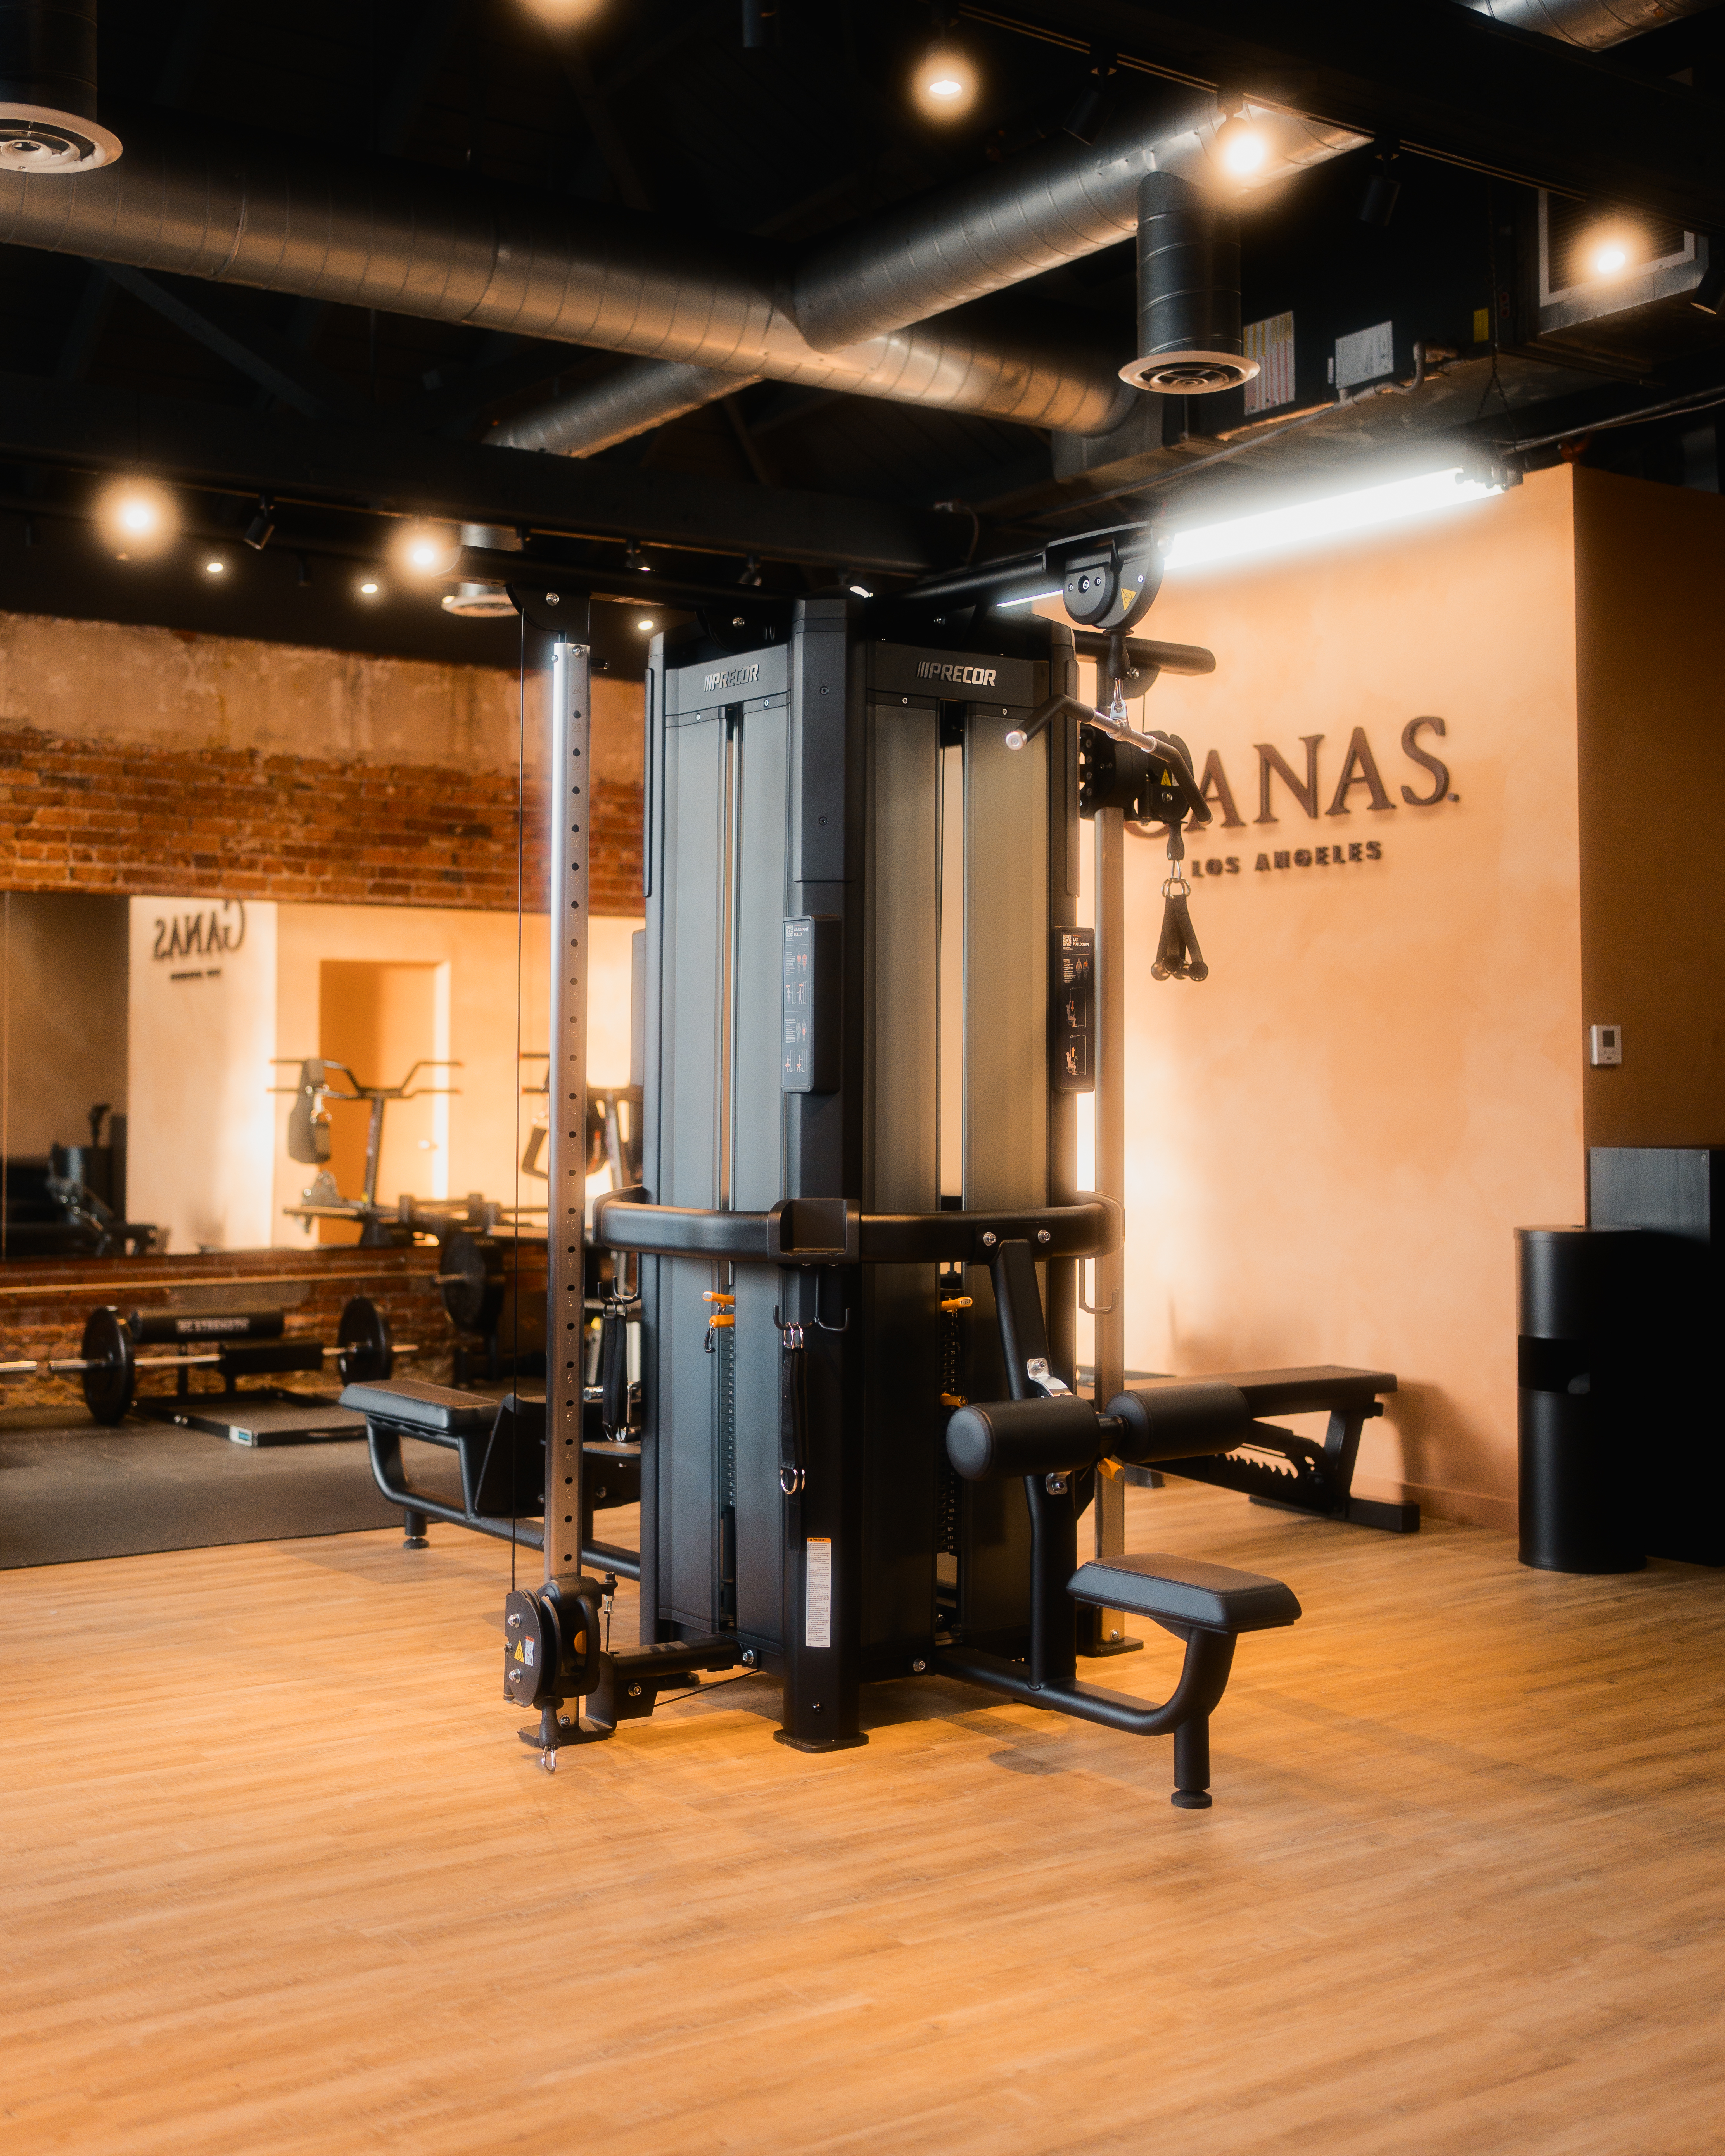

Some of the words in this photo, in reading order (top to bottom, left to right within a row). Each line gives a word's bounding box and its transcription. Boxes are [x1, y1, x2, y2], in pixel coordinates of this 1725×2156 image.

[711, 664, 759, 691] PRECOR
[928, 663, 996, 687] PRECOR
[572, 685, 581, 694] 24
[572, 723, 582, 733] 23
[571, 761, 581, 771] 22
[1124, 716, 1460, 839] ANAS.
[570, 838, 580, 847] 20
[1191, 856, 1240, 878] LOS
[1255, 841, 1382, 871] ANGELES
[570, 876, 579, 885] 19
[570, 914, 579, 923] 18
[569, 952, 579, 961] 17
[569, 990, 578, 999] 16
[567, 1105, 577, 1114] 13
[567, 1143, 577, 1153] 12
[567, 1220, 576, 1229] 10
[568, 1258, 573, 1268] 9
[568, 1297, 573, 1306] 8
[567, 1334, 573, 1345] 7
[567, 1373, 572, 1383] 6
[567, 1411, 572, 1422] 5
[566, 1449, 572, 1460] 4
[566, 1488, 571, 1498] 3
